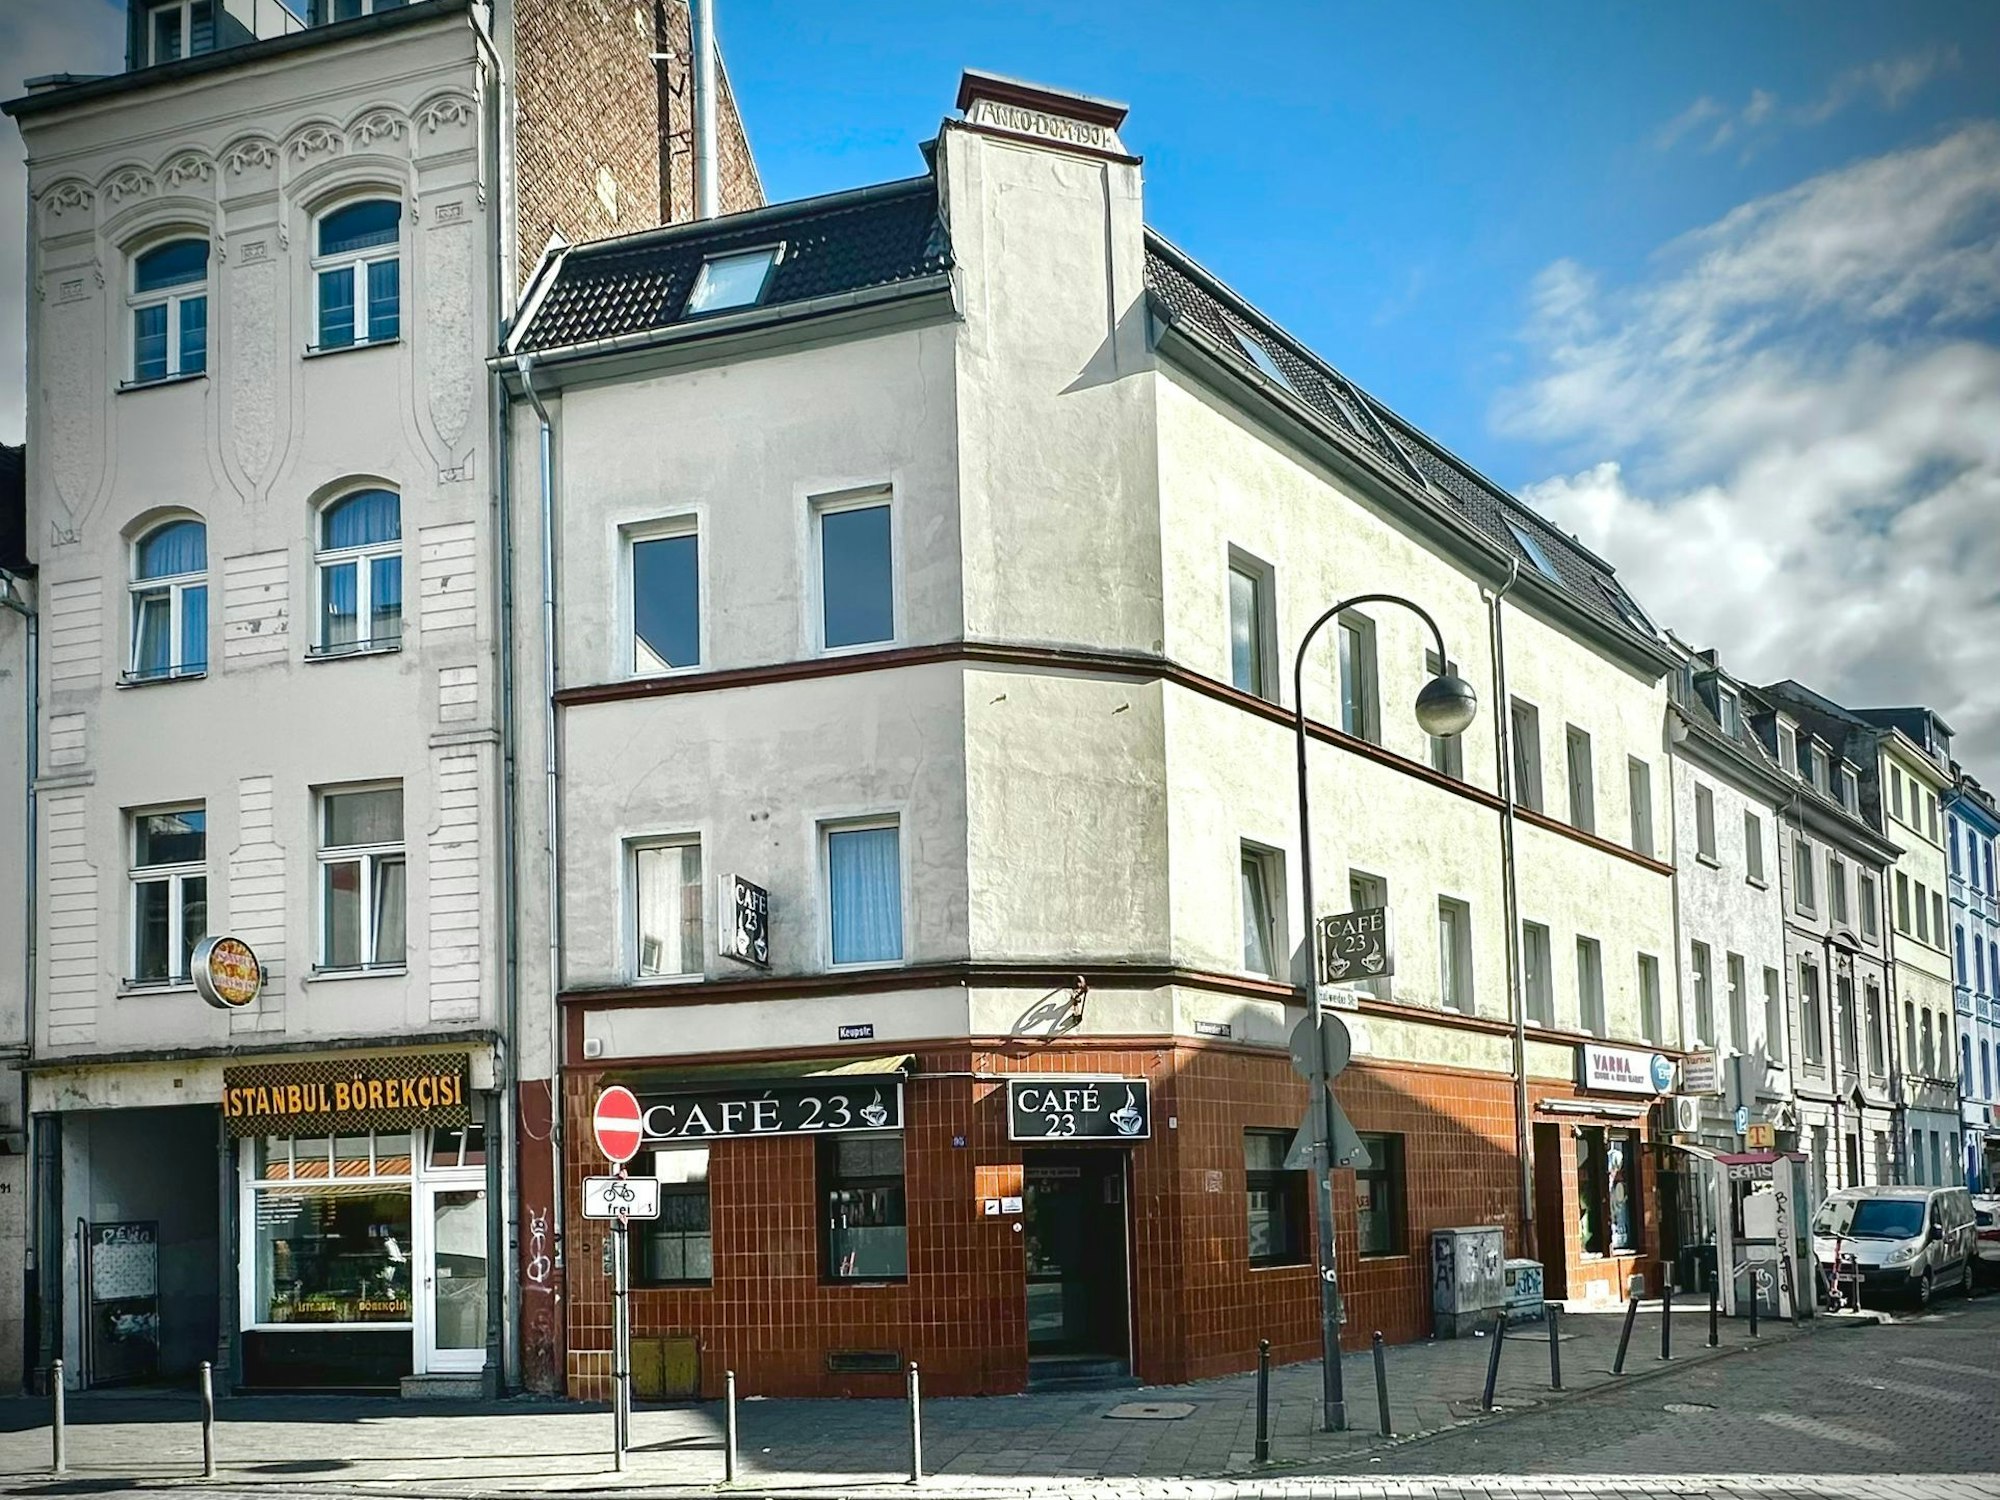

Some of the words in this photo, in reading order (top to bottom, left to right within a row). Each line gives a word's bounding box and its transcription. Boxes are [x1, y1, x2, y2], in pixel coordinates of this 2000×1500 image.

[982, 102, 1032, 132] ANNO
[744, 909, 757, 931] 23
[1326, 908, 1384, 938] CAFÉ
[1344, 934, 1366, 953] 23
[1593, 1054, 1632, 1074] VARNA
[1017, 1083, 1101, 1113] CAFÉ
[642, 1090, 782, 1137] CAFÉ
[798, 1095, 852, 1129] 23
[1045, 1113, 1076, 1137] 23
[1749, 1126, 1766, 1146] T
[608, 1203, 630, 1215] frei
